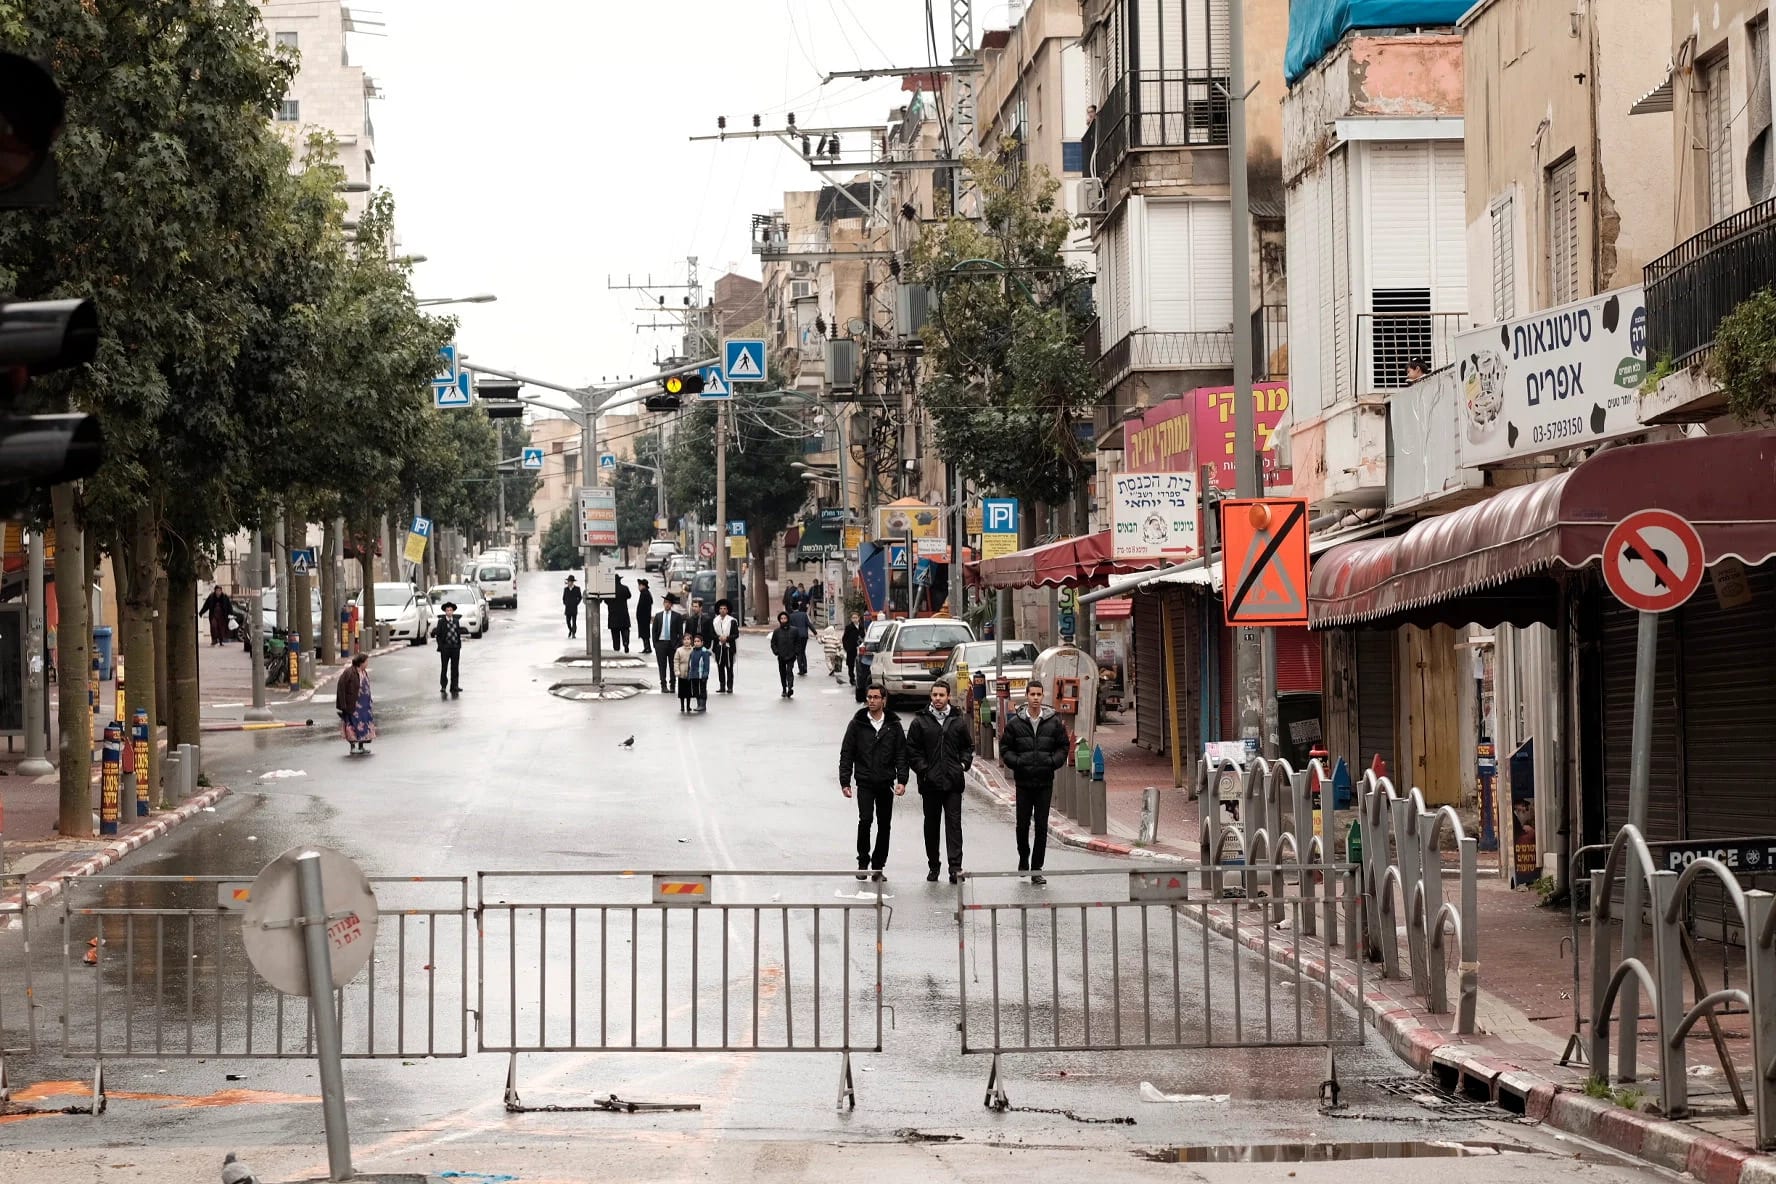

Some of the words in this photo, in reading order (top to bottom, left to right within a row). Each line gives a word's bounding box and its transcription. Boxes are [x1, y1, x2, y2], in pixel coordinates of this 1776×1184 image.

[1513, 308, 1592, 361] סיטונאות
[1526, 361, 1584, 406] אפרים
[1533, 416, 1583, 443] 03-5793150
[1117, 475, 1159, 494] הכנסת
[1167, 476, 1191, 492] בית
[1125, 499, 1161, 508] יוחאי
[1168, 499, 1185, 507] בר
[1117, 522, 1138, 533] הבאים
[1173, 521, 1194, 531] ברוכים
[134, 753, 149, 769] 100%
[103, 775, 118, 791] 100%
